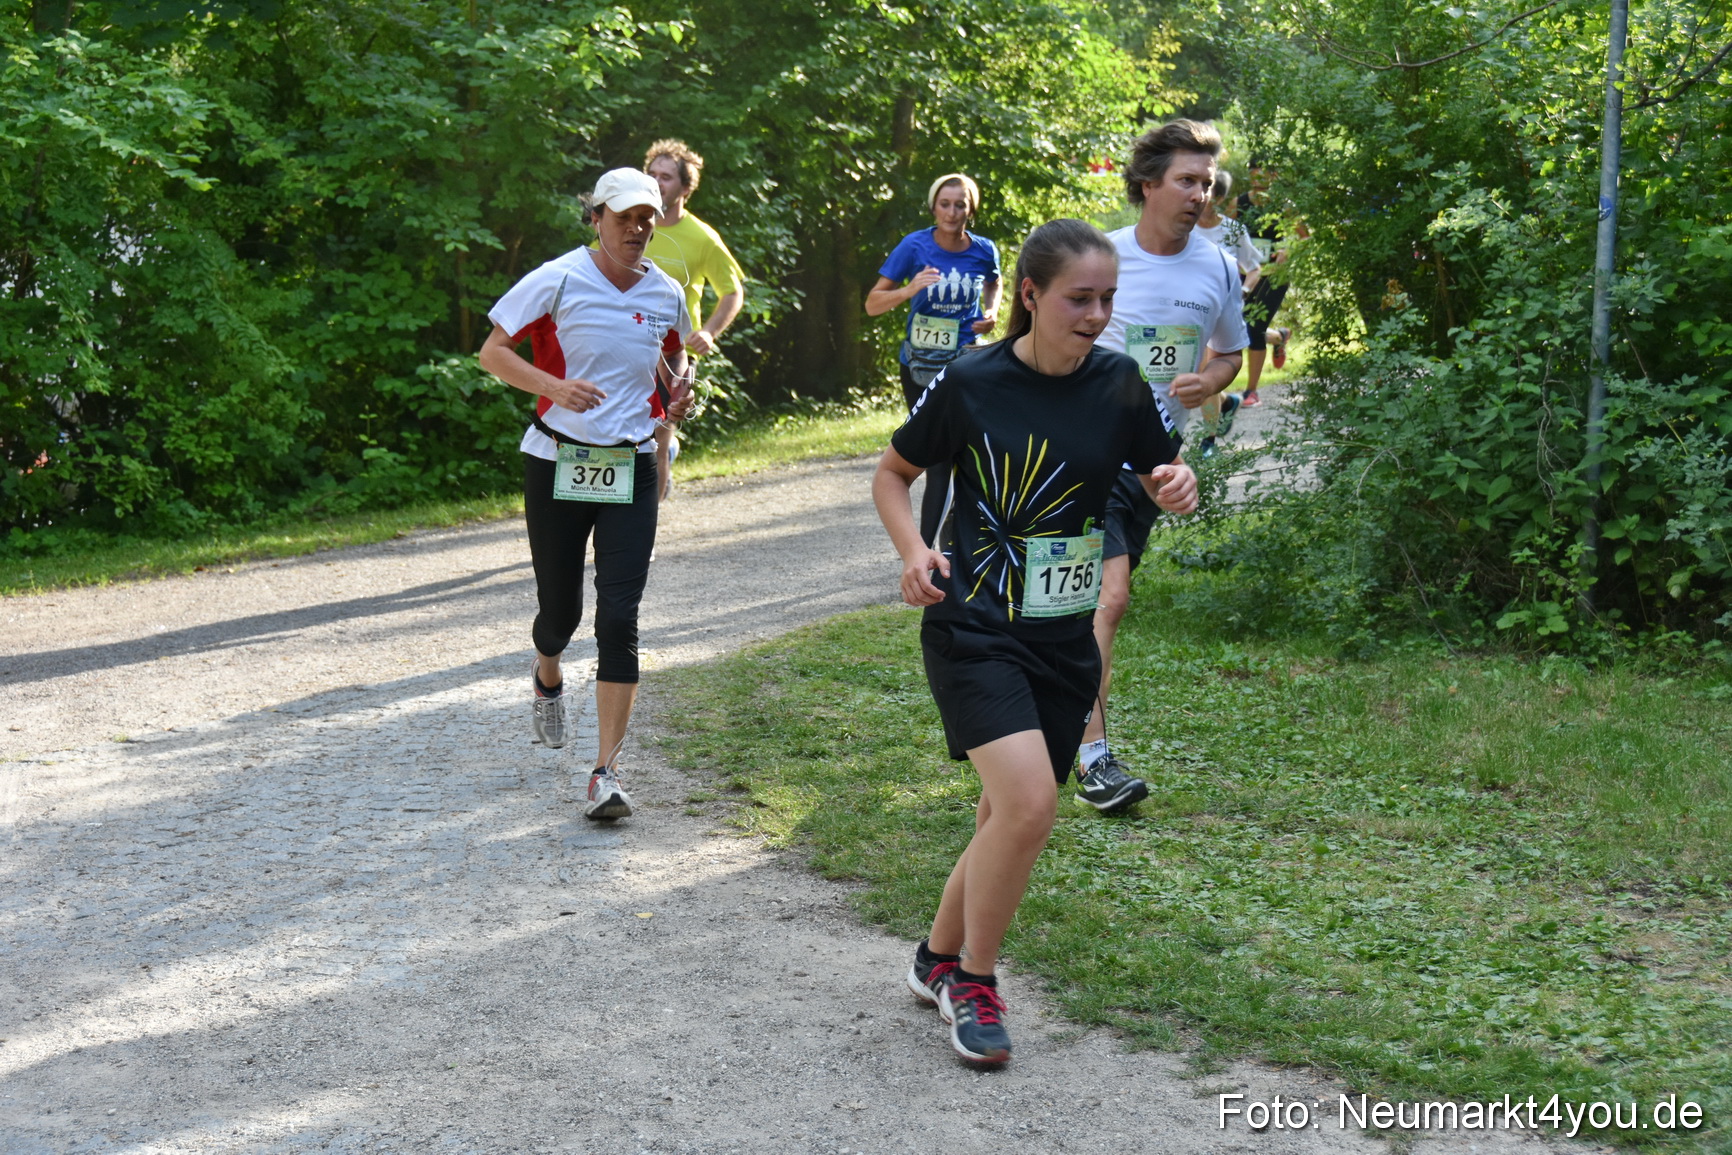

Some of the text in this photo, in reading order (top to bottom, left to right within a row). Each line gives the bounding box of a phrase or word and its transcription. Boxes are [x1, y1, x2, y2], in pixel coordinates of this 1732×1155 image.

[915, 327, 951, 346] 1713
[1149, 345, 1176, 366] 28
[572, 465, 616, 487] 370
[1039, 561, 1094, 595] 1756
